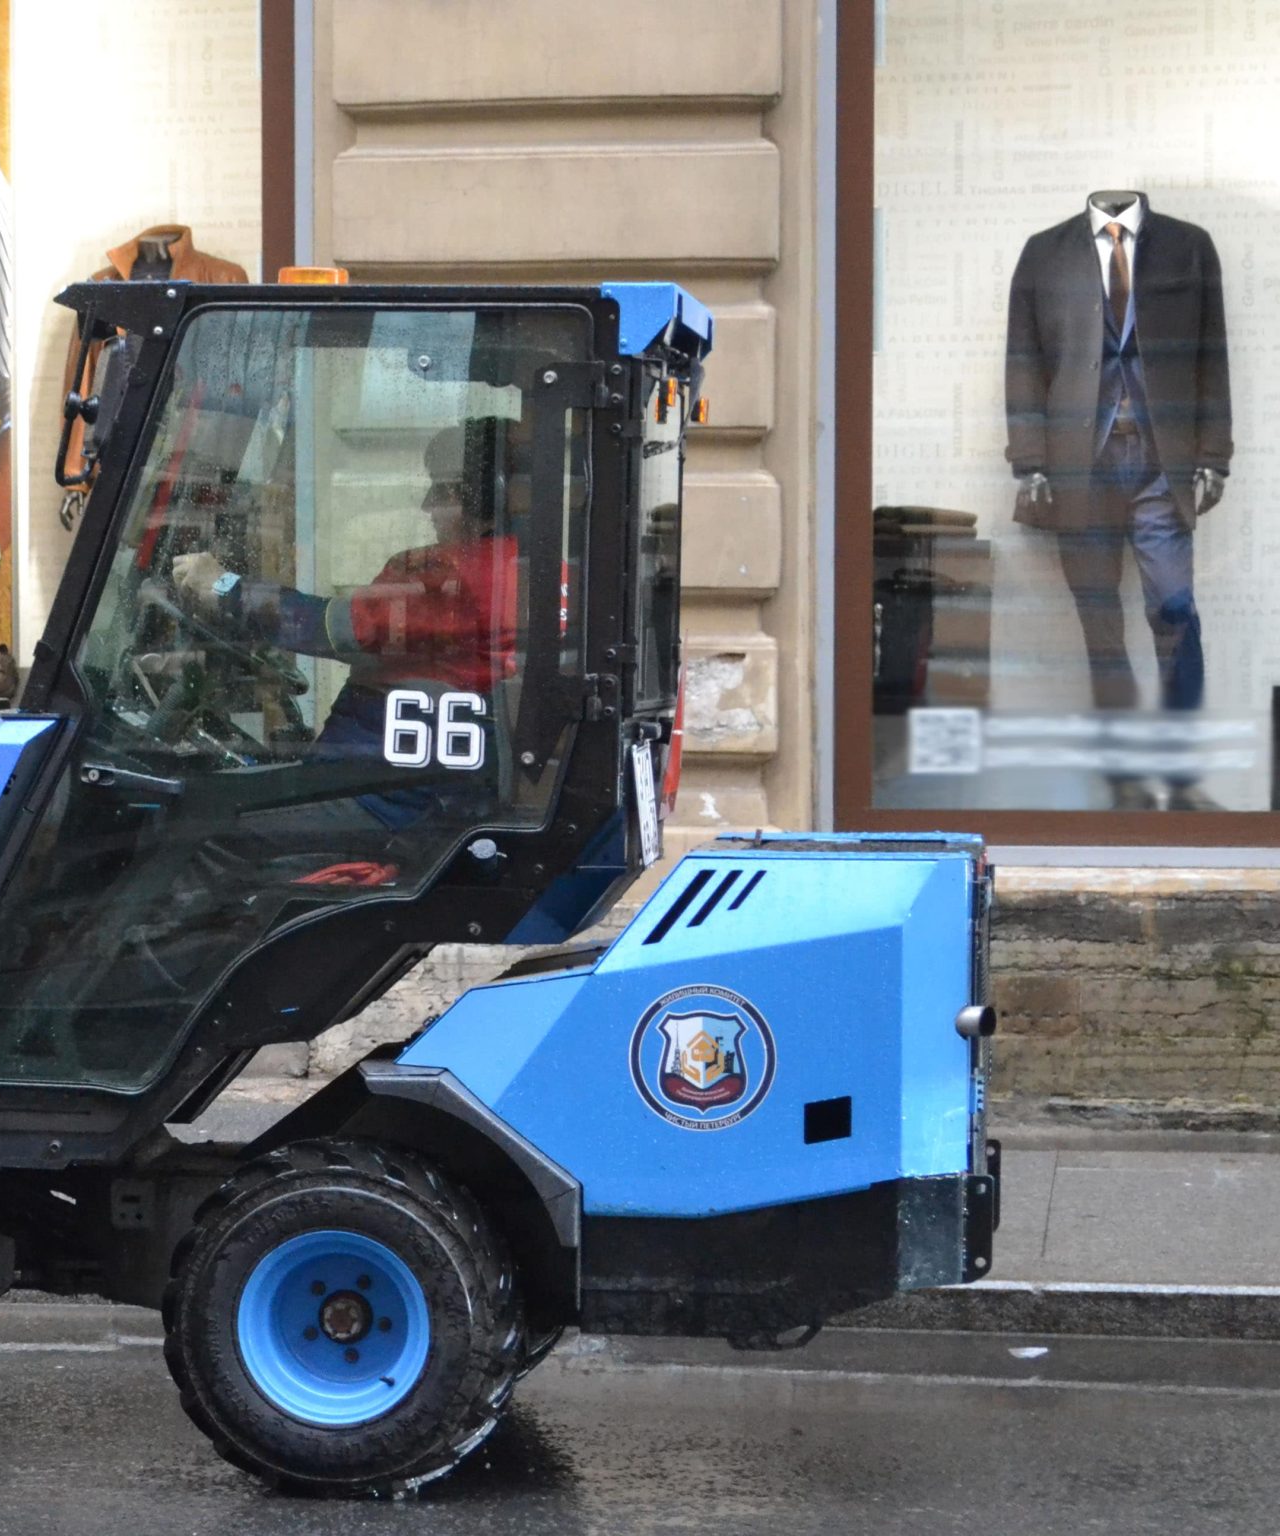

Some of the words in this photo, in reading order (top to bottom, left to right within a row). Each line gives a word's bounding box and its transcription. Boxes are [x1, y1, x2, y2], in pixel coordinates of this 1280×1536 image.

[1012, 17, 1059, 34] pierre
[1064, 15, 1115, 30] cardin
[968, 183, 1027, 196] THOMAS
[1241, 241, 1255, 270] ONE
[1241, 273, 1255, 308] GATE
[952, 382, 965, 459] MILESTONE
[383, 689, 487, 770] 66
[659, 986, 710, 1006] ЖИЛИЩНЫЙ
[709, 987, 746, 1006] КОМИТЕТ
[664, 1111, 699, 1129] ЧИСТЫЙ
[699, 1112, 742, 1130] ПЕТЕРБУРГ
